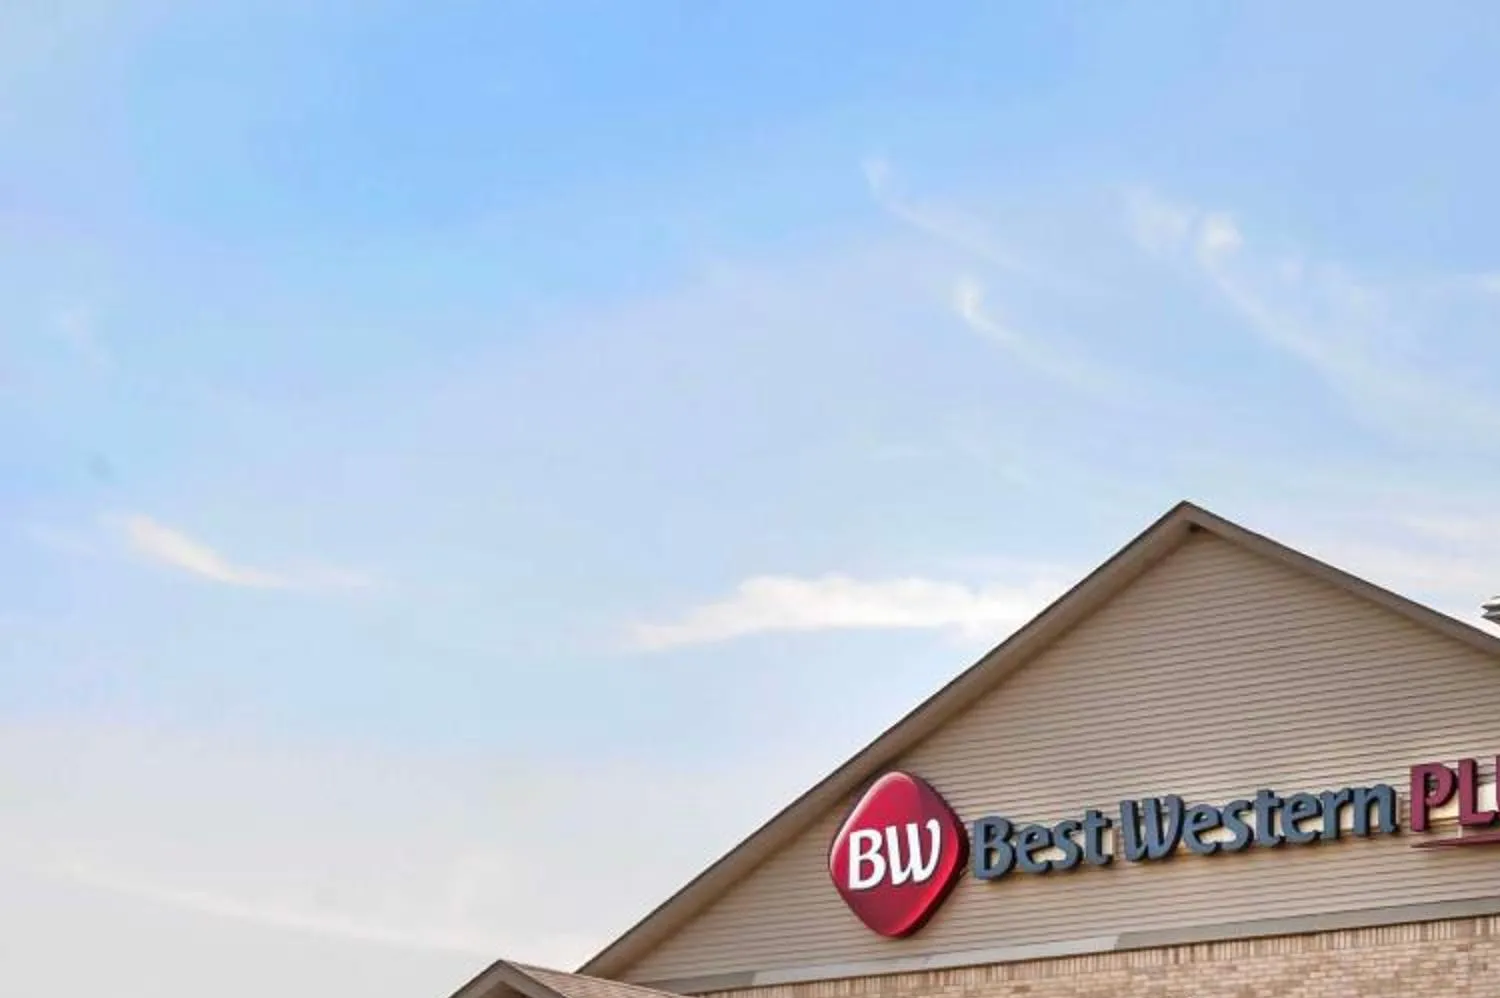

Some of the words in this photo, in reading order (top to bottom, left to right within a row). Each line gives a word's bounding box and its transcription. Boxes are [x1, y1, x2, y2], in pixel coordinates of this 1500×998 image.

[848, 818, 942, 891] BW
[972, 810, 1113, 882] Best
[1120, 783, 1399, 862] Western
